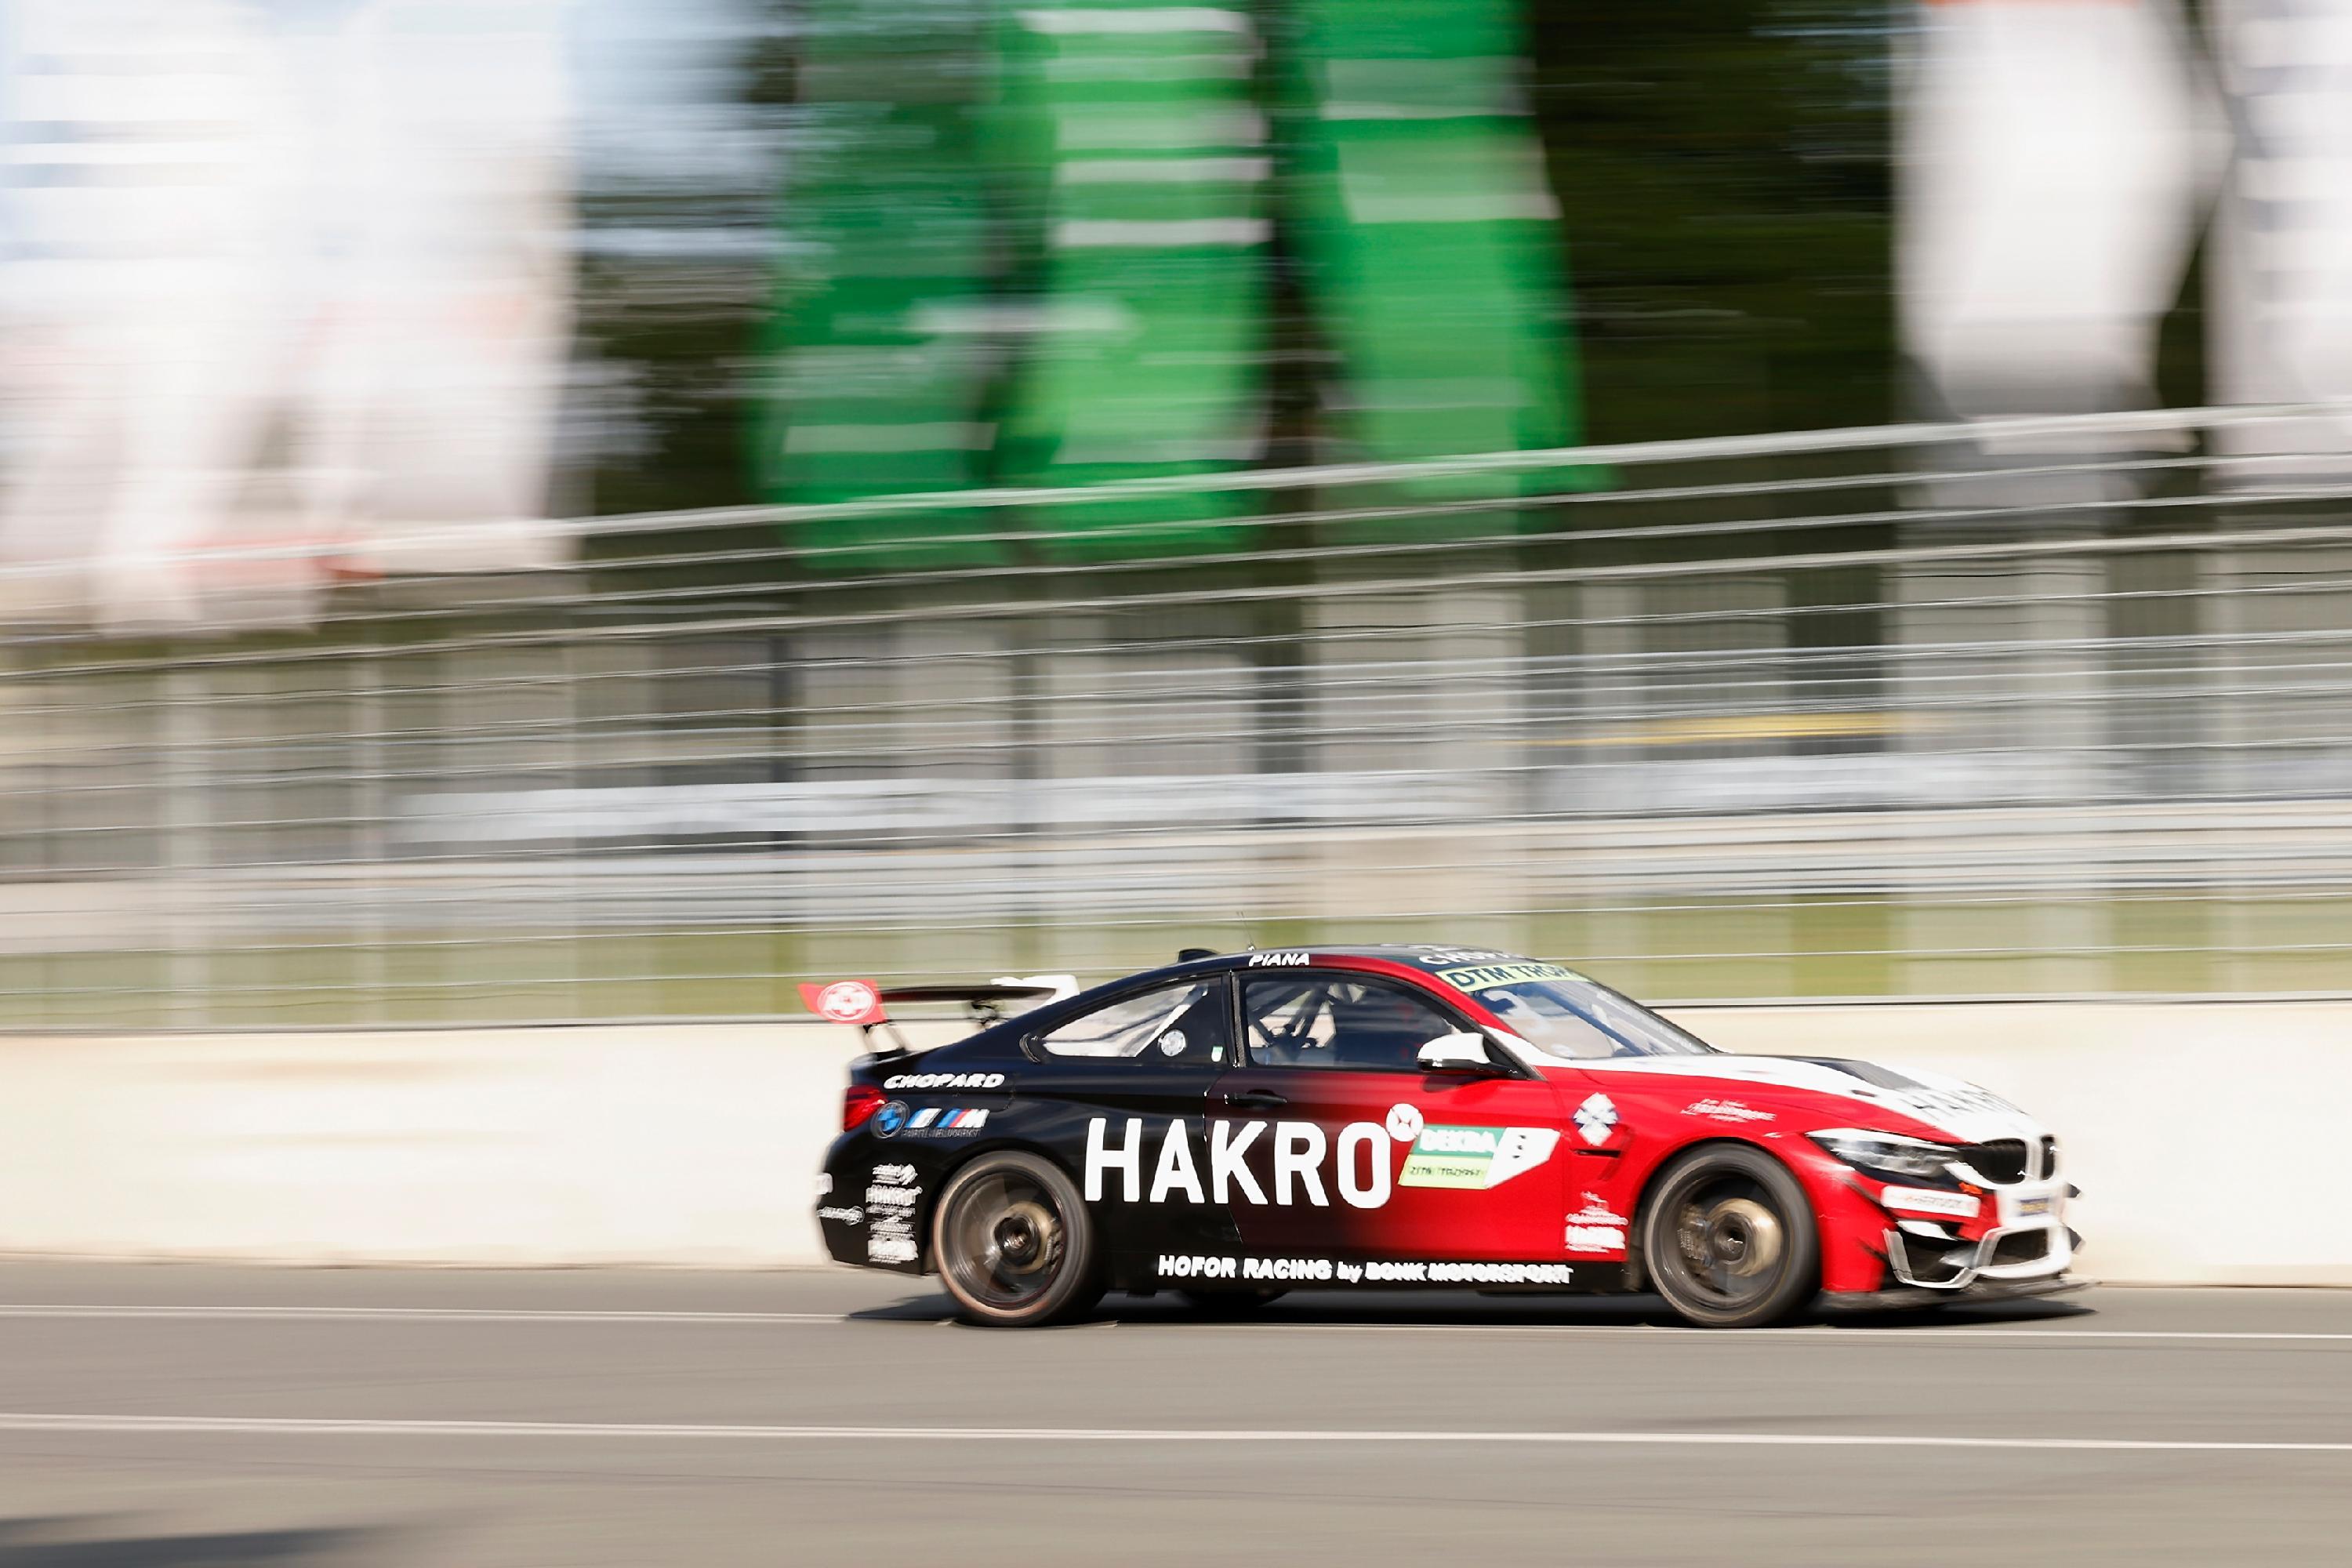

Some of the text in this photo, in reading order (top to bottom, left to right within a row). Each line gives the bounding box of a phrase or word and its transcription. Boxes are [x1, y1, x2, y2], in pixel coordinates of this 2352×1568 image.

[1248, 953, 1310, 967] PIANA
[1446, 966, 1516, 987] DTM
[883, 1073, 1005, 1090] CHOPARD
[1084, 1117, 1392, 1209] HAKRO
[1158, 1254, 1236, 1279] HOFOR
[1243, 1258, 1333, 1280] RACING
[1336, 1261, 1363, 1283] by
[1427, 1262, 1574, 1284] MOTORSPORT
